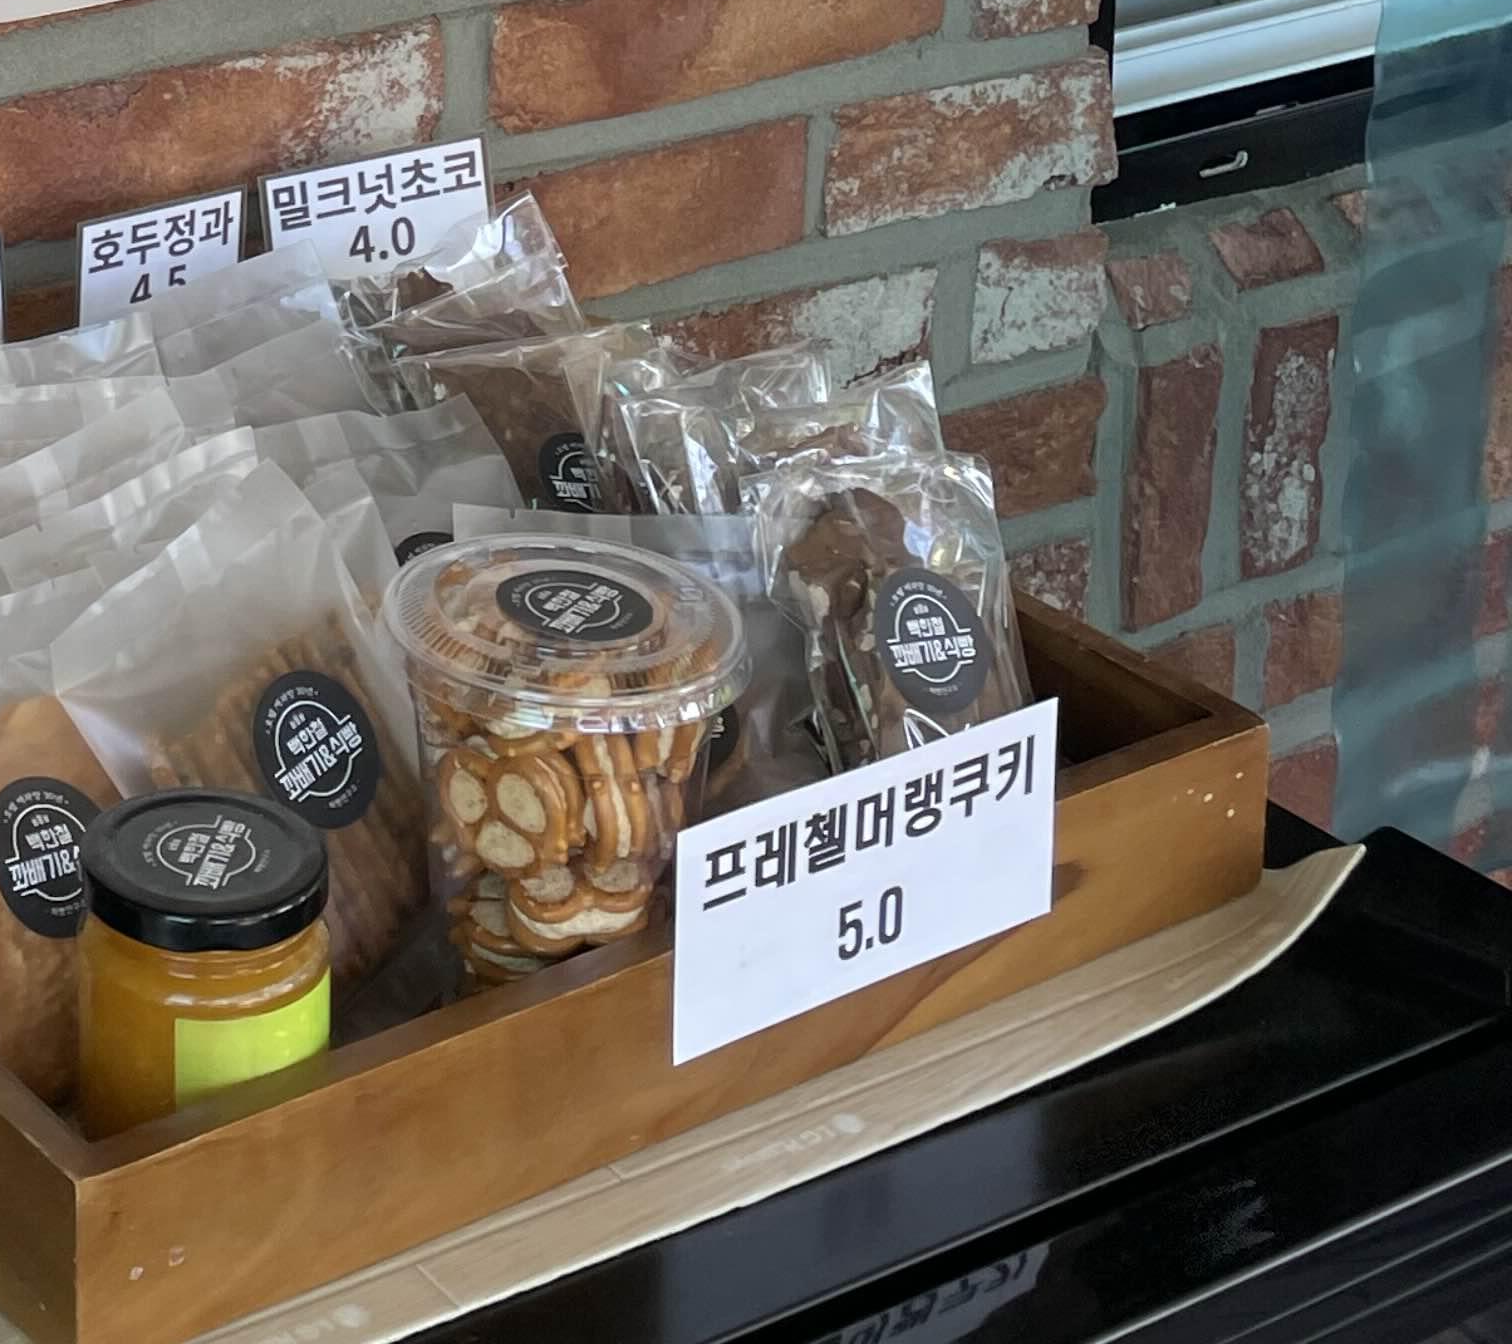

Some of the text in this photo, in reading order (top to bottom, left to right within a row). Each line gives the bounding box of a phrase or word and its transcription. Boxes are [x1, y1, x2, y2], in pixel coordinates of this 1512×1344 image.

[272, 146, 482, 230] 밀크넛초코
[88, 200, 236, 274] 호두정과
[348, 216, 416, 262] 4.0
[702, 734, 1036, 911] 프레첼머랭쿠키
[839, 886, 902, 960] 5.0
